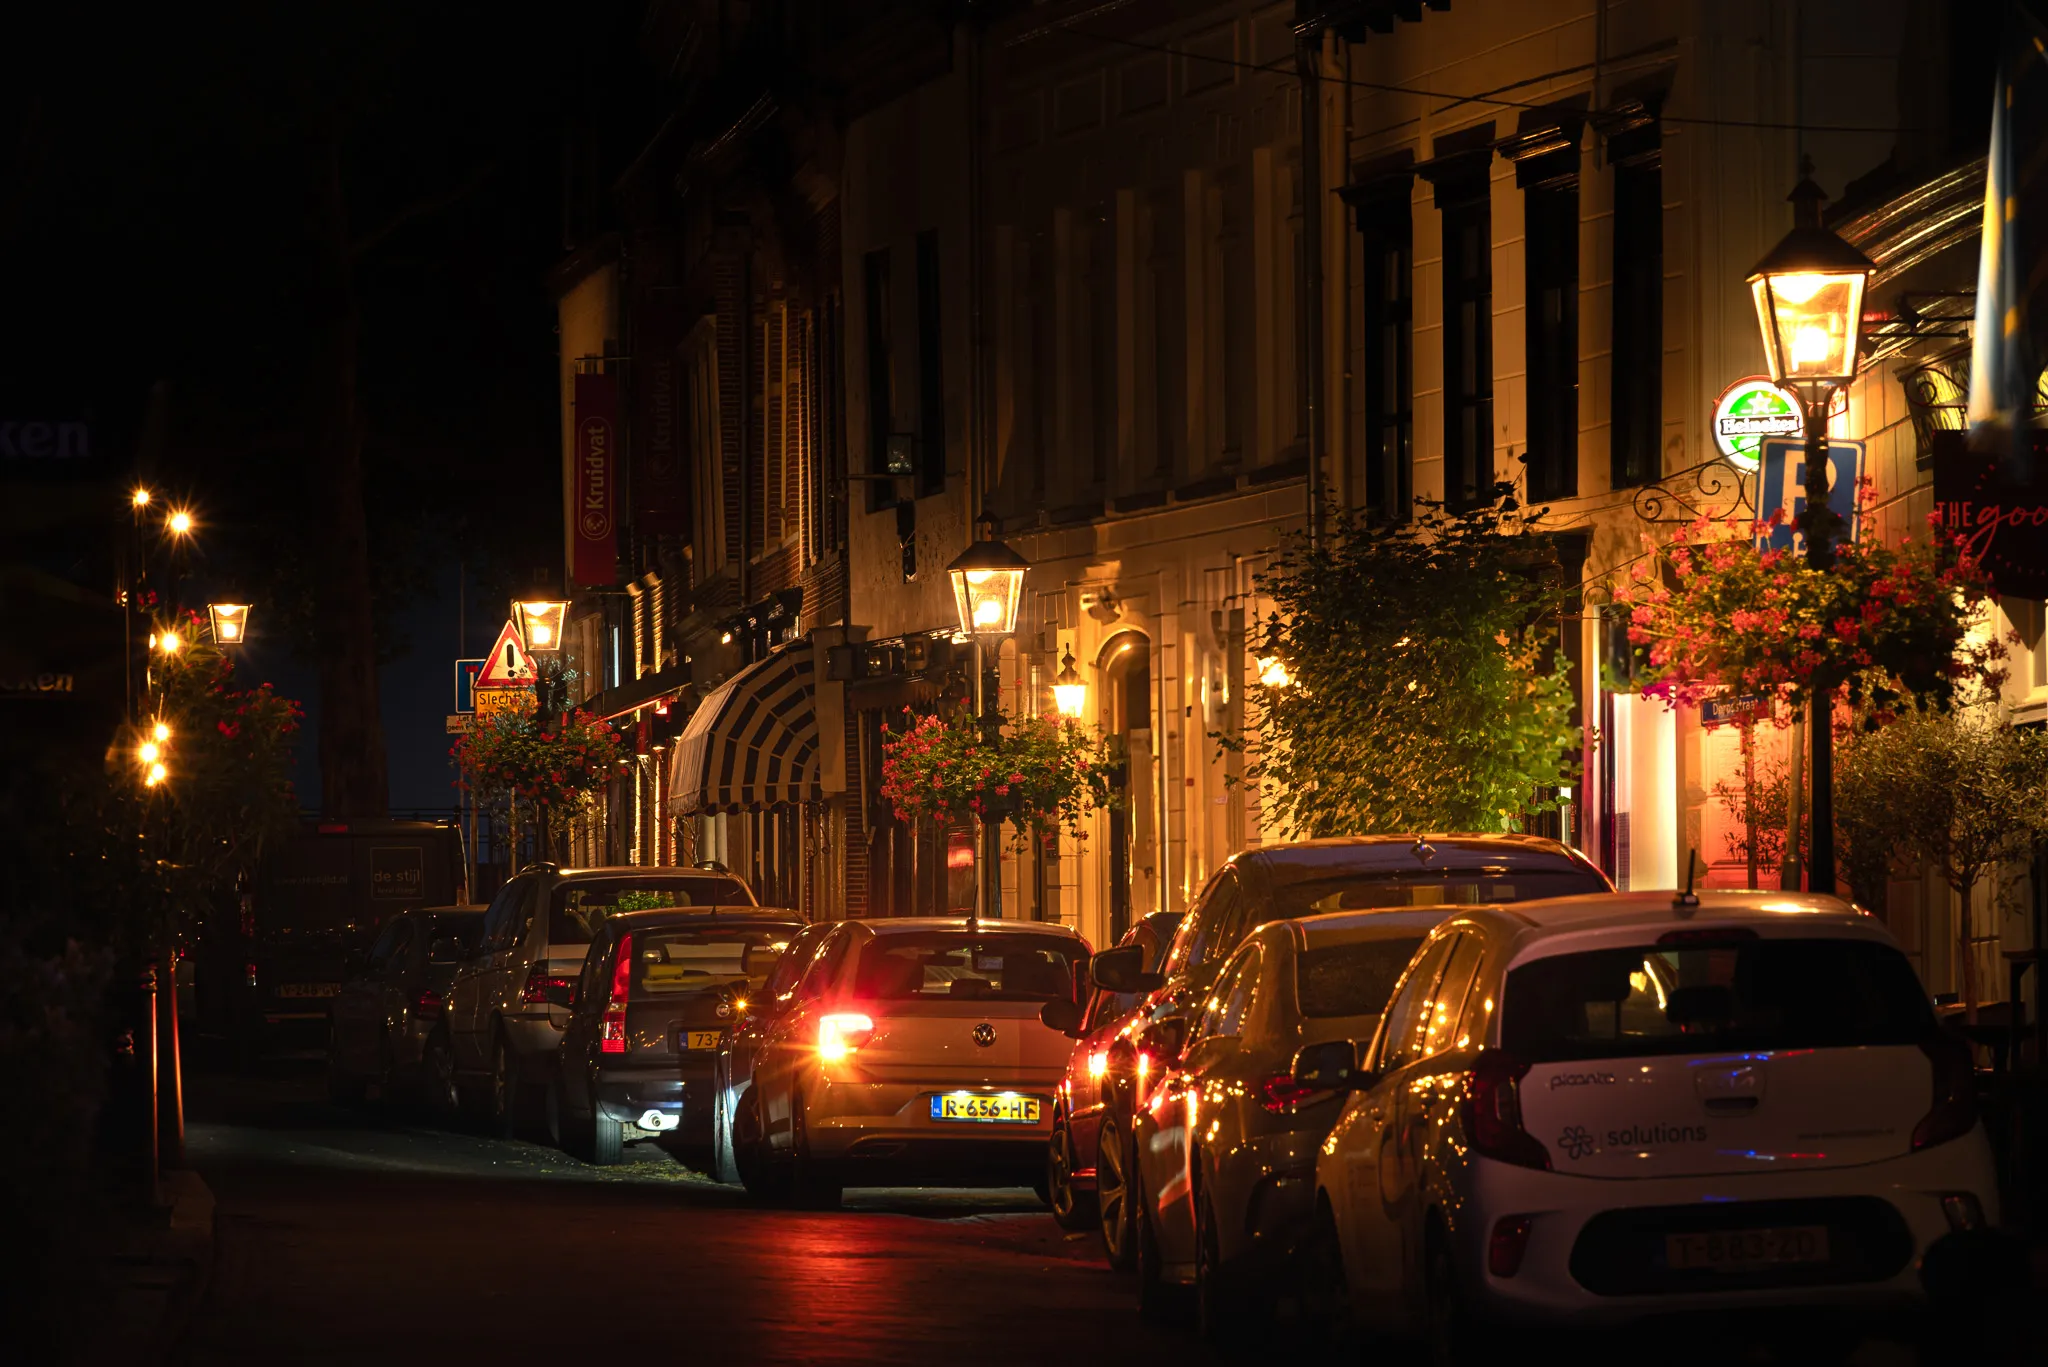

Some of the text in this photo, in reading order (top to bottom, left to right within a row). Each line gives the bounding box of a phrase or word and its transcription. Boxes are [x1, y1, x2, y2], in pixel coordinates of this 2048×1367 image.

[650, 359, 672, 451] Kruidvat
[585, 426, 605, 509] Kruidvat
[1936, 501, 1973, 527] THE
[1712, 698, 1760, 716] Dorpsstraa
[373, 869, 421, 885] de stijl
[945, 1099, 1036, 1119] R-656-HF
[1607, 1121, 1708, 1147] solutions
